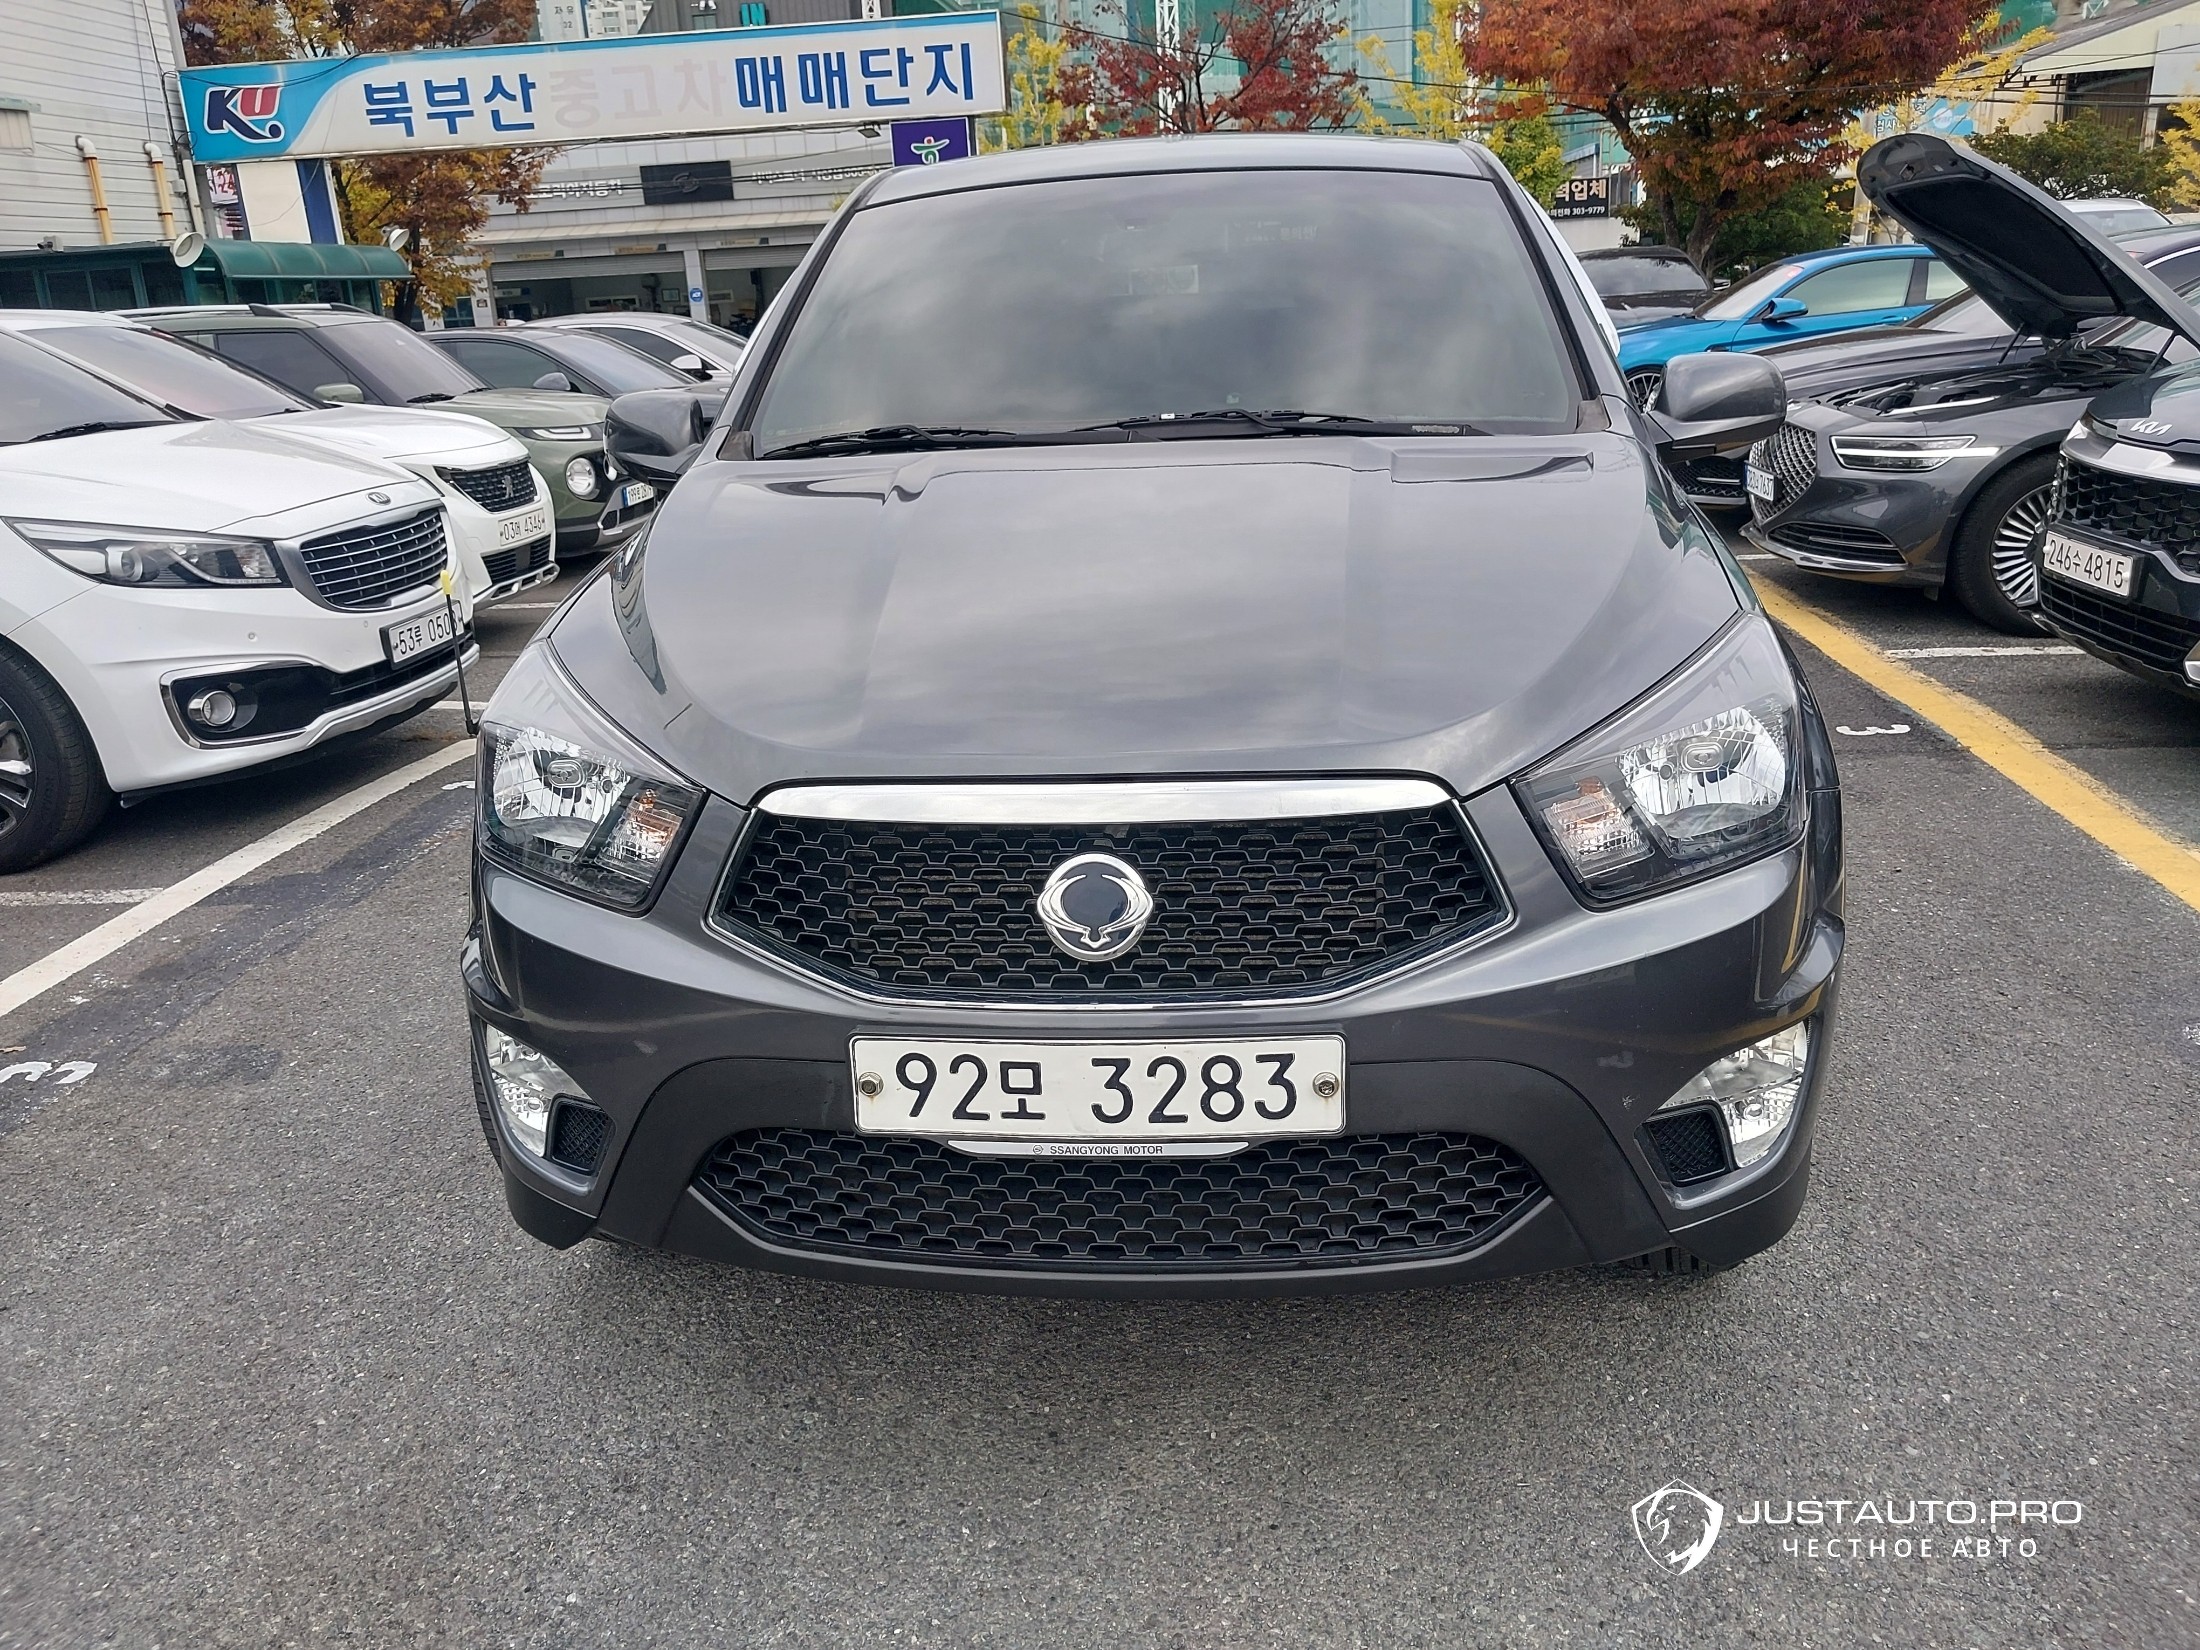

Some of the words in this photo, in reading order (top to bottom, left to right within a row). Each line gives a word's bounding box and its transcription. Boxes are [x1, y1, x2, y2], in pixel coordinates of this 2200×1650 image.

[204, 85, 285, 143] KU
[363, 72, 537, 138] 북부산
[734, 42, 975, 115] 매매단지
[2048, 539, 2082, 574] 246수
[2083, 552, 2126, 589] 4815
[397, 625, 423, 655] 53루
[895, 1052, 1046, 1121] 92모
[1090, 1052, 1298, 1124] 3283
[1049, 1145, 1120, 1155] SSANGYONG
[1123, 1145, 1164, 1155] MOTOR
